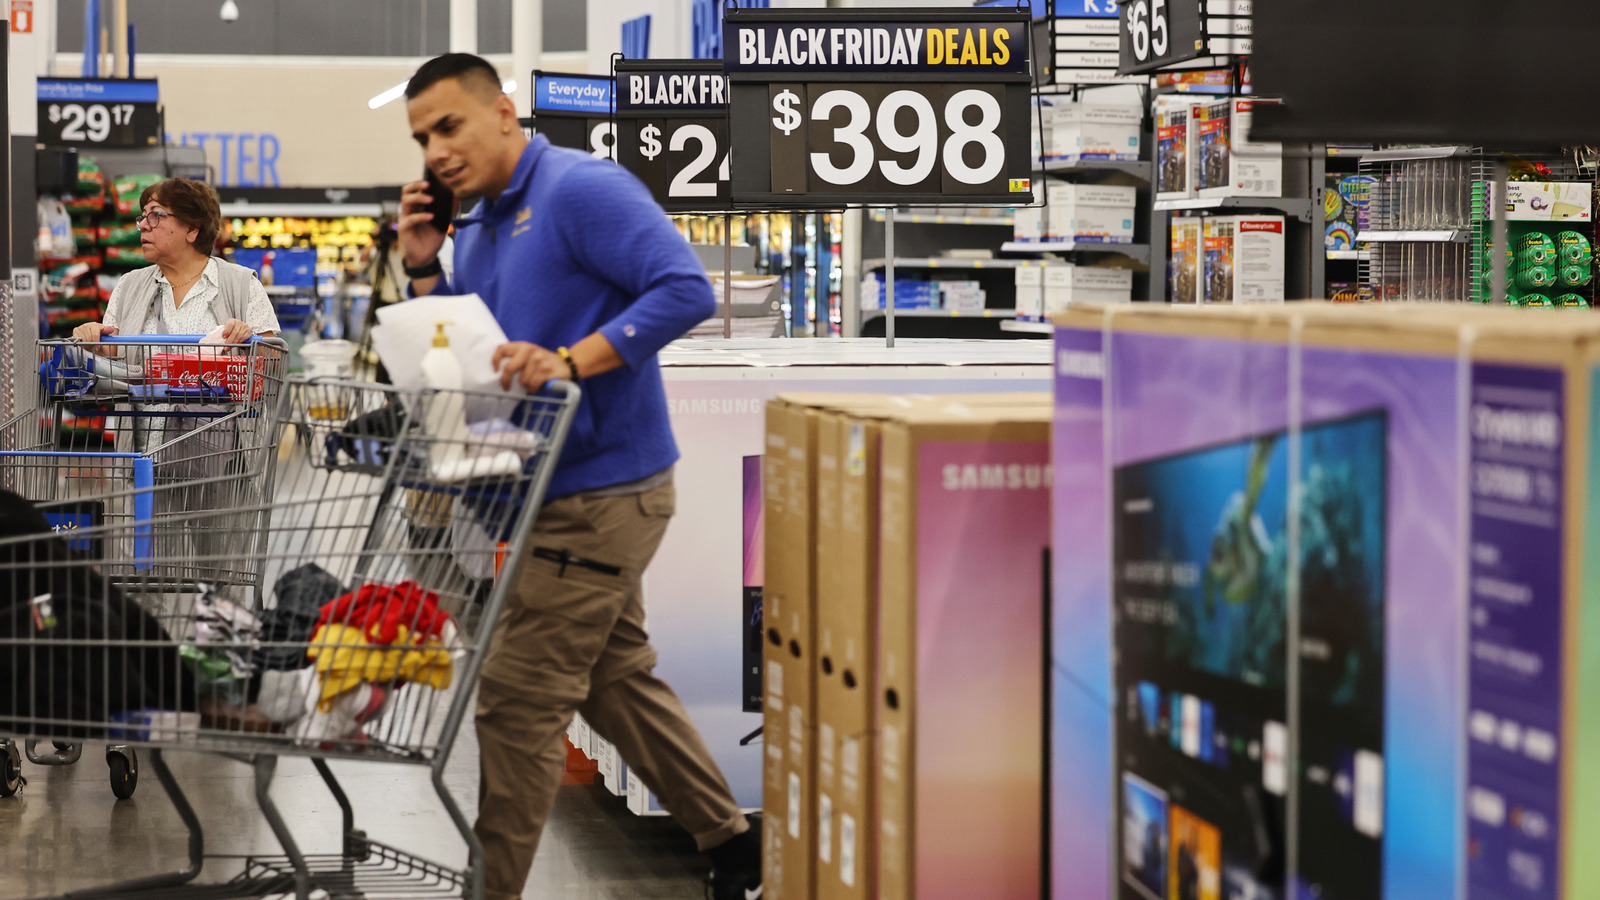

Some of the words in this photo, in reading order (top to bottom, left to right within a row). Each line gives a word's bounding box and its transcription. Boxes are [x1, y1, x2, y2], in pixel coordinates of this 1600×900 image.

[738, 27, 827, 66] BLACK
[830, 27, 923, 66] FRIDAY
[926, 27, 1011, 66] DEALS
[548, 80, 606, 101] Everyday
[629, 74, 697, 105] BLACK
[668, 398, 761, 415] SAMSUNG
